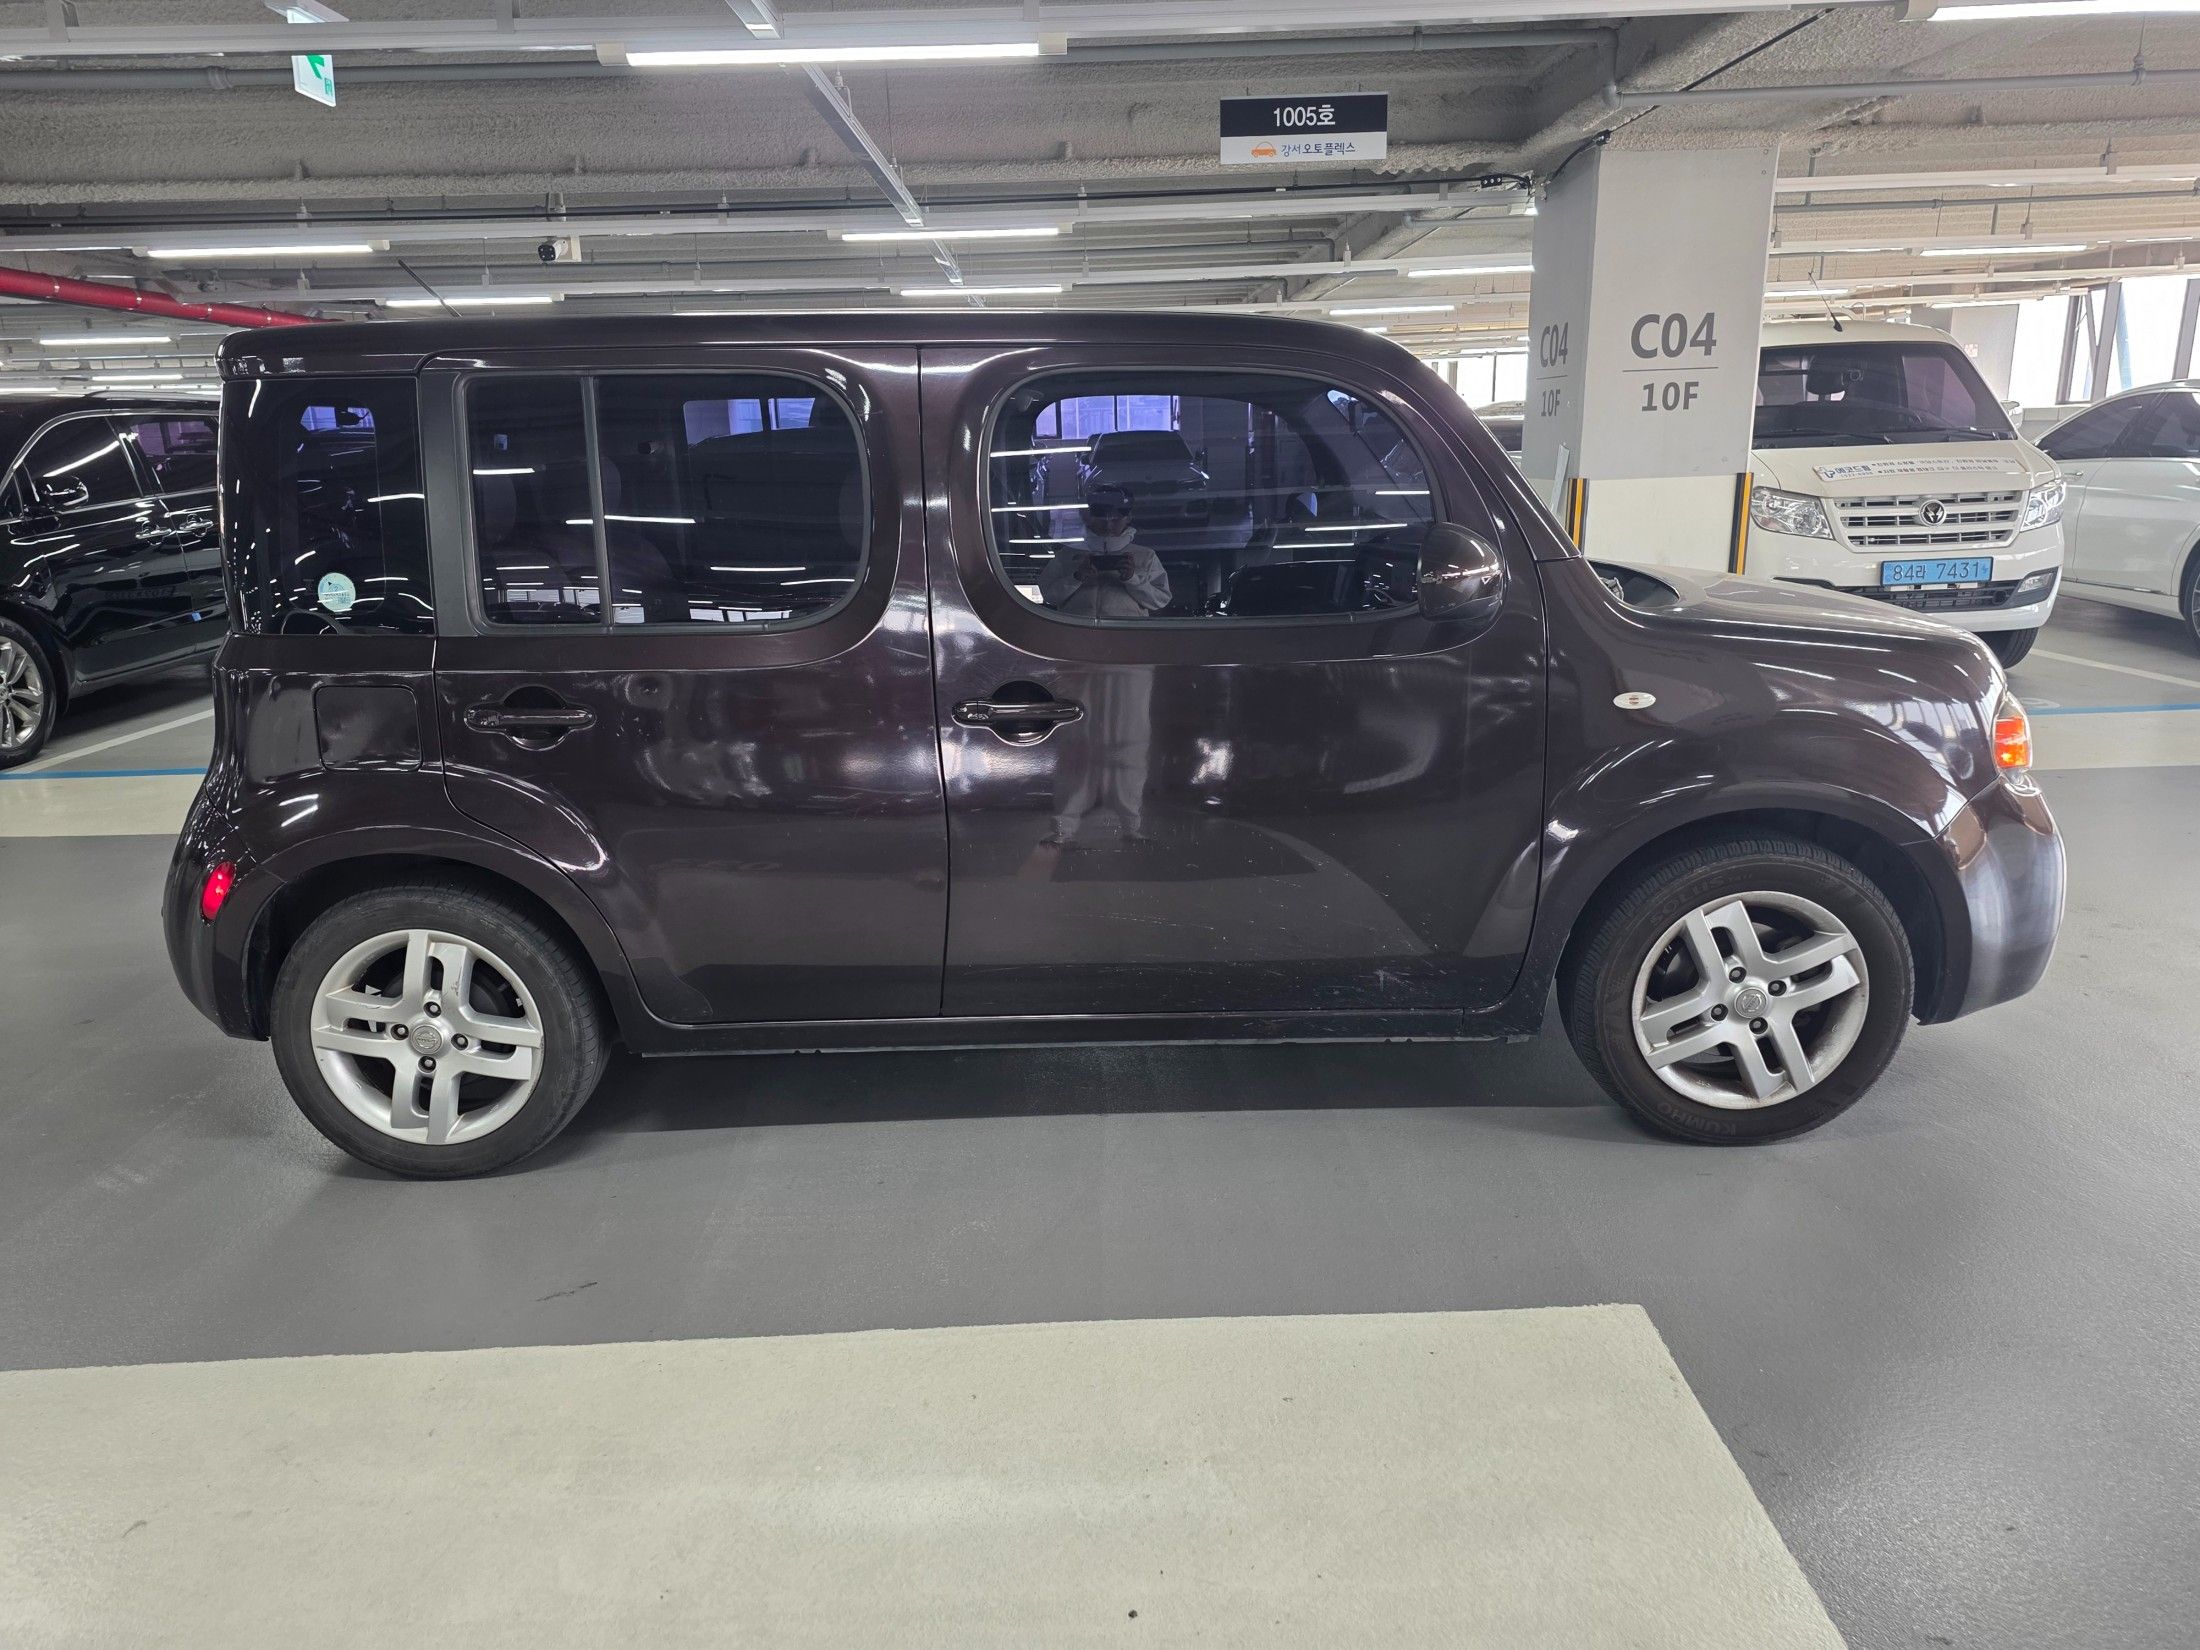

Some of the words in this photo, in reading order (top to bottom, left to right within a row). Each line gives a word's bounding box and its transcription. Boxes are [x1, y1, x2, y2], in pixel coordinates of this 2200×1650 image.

[1273, 104, 1336, 127] 1005호
[1540, 322, 1569, 368] C04
[1630, 312, 1717, 359] C04
[1540, 388, 1561, 417] 10F
[1641, 381, 1700, 412] 10F
[1892, 564, 1927, 582] 84라
[1936, 561, 1980, 580] 7431
[1656, 1101, 1737, 1137] KUMHO
